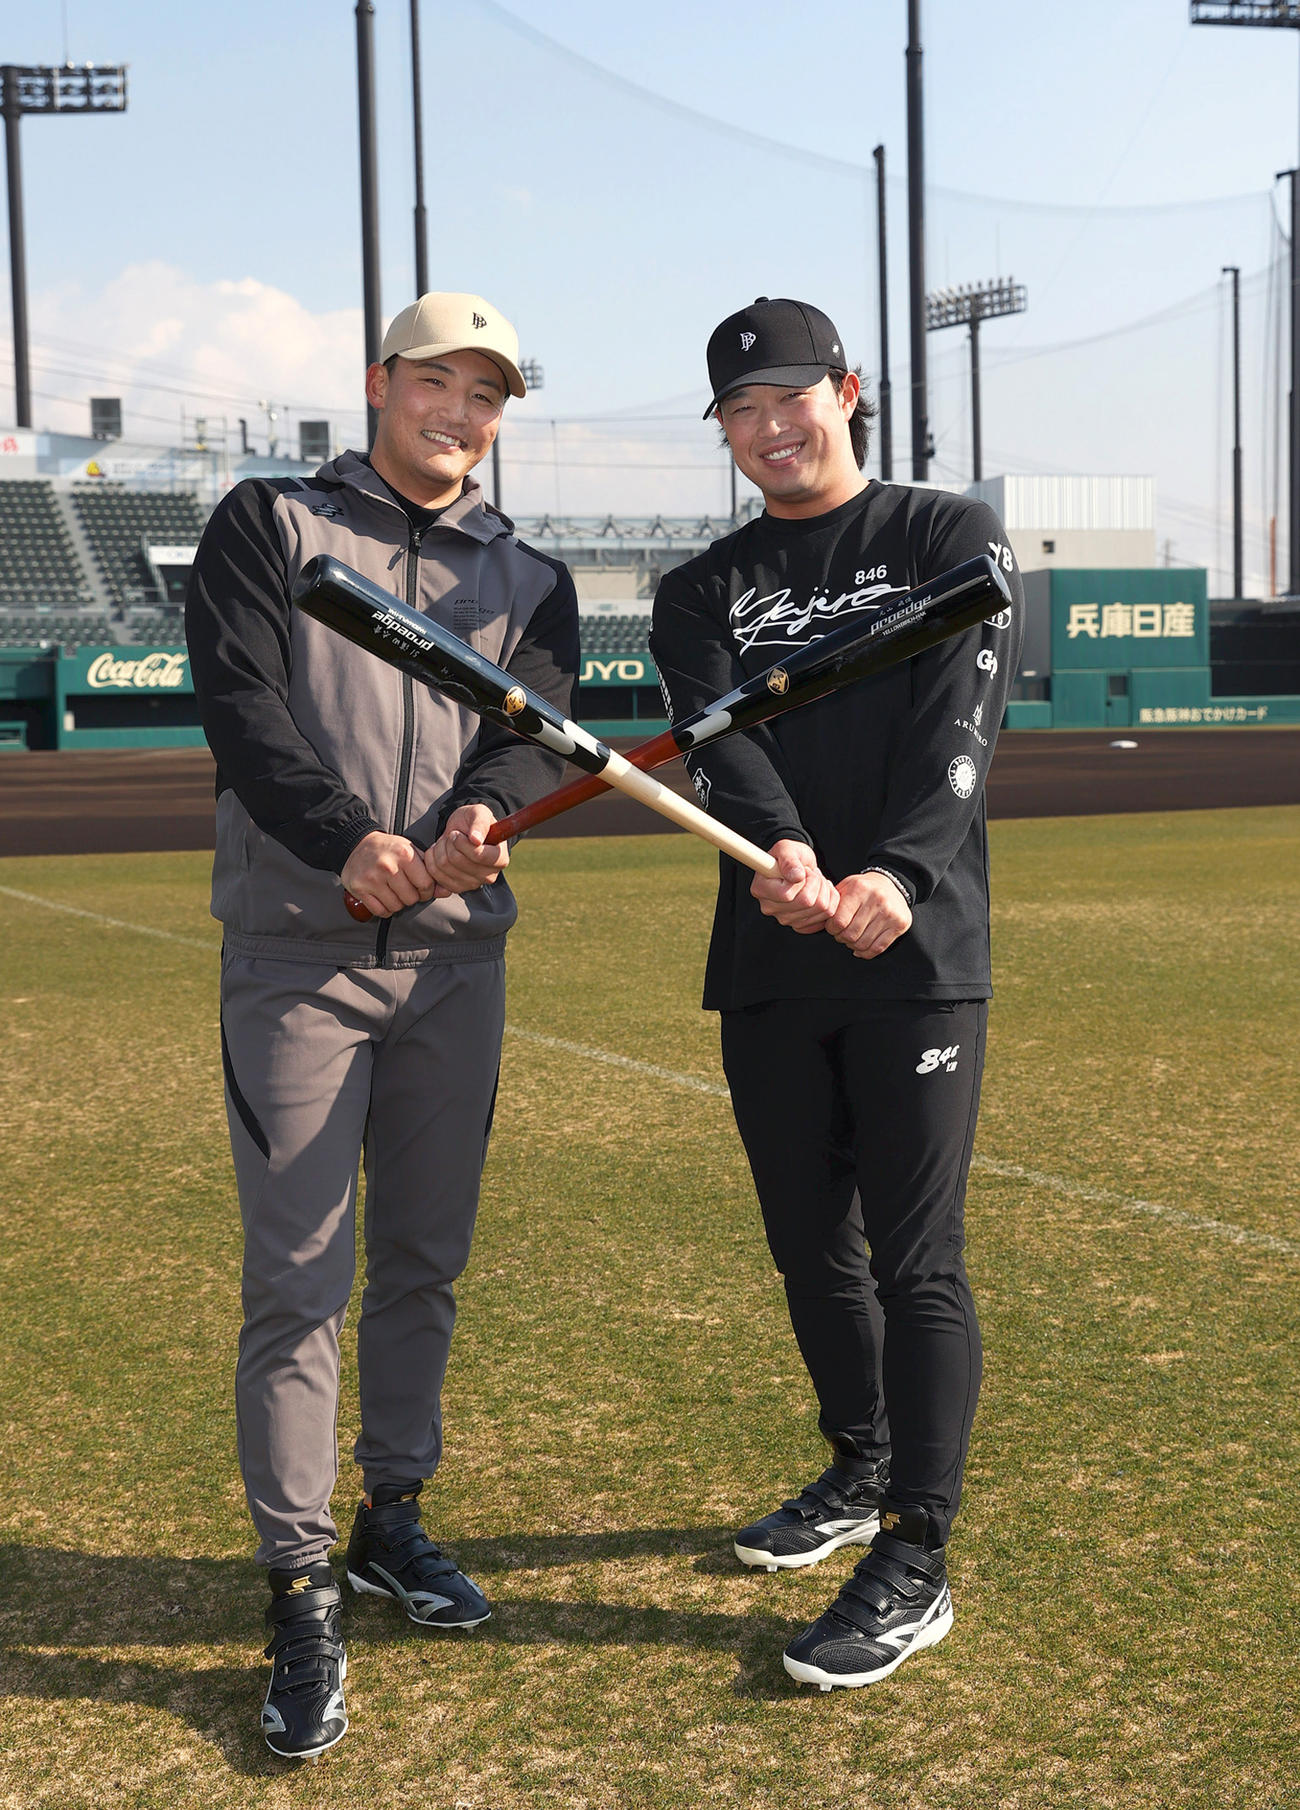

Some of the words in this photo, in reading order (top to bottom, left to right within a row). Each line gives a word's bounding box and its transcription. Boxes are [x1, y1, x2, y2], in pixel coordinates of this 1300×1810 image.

[854, 564, 888, 585] 846
[371, 610, 435, 652] proedge
[870, 594, 932, 635] proedge
[1066, 602, 1195, 638] 兵庫日産
[87, 652, 189, 689] Coca-Cola
